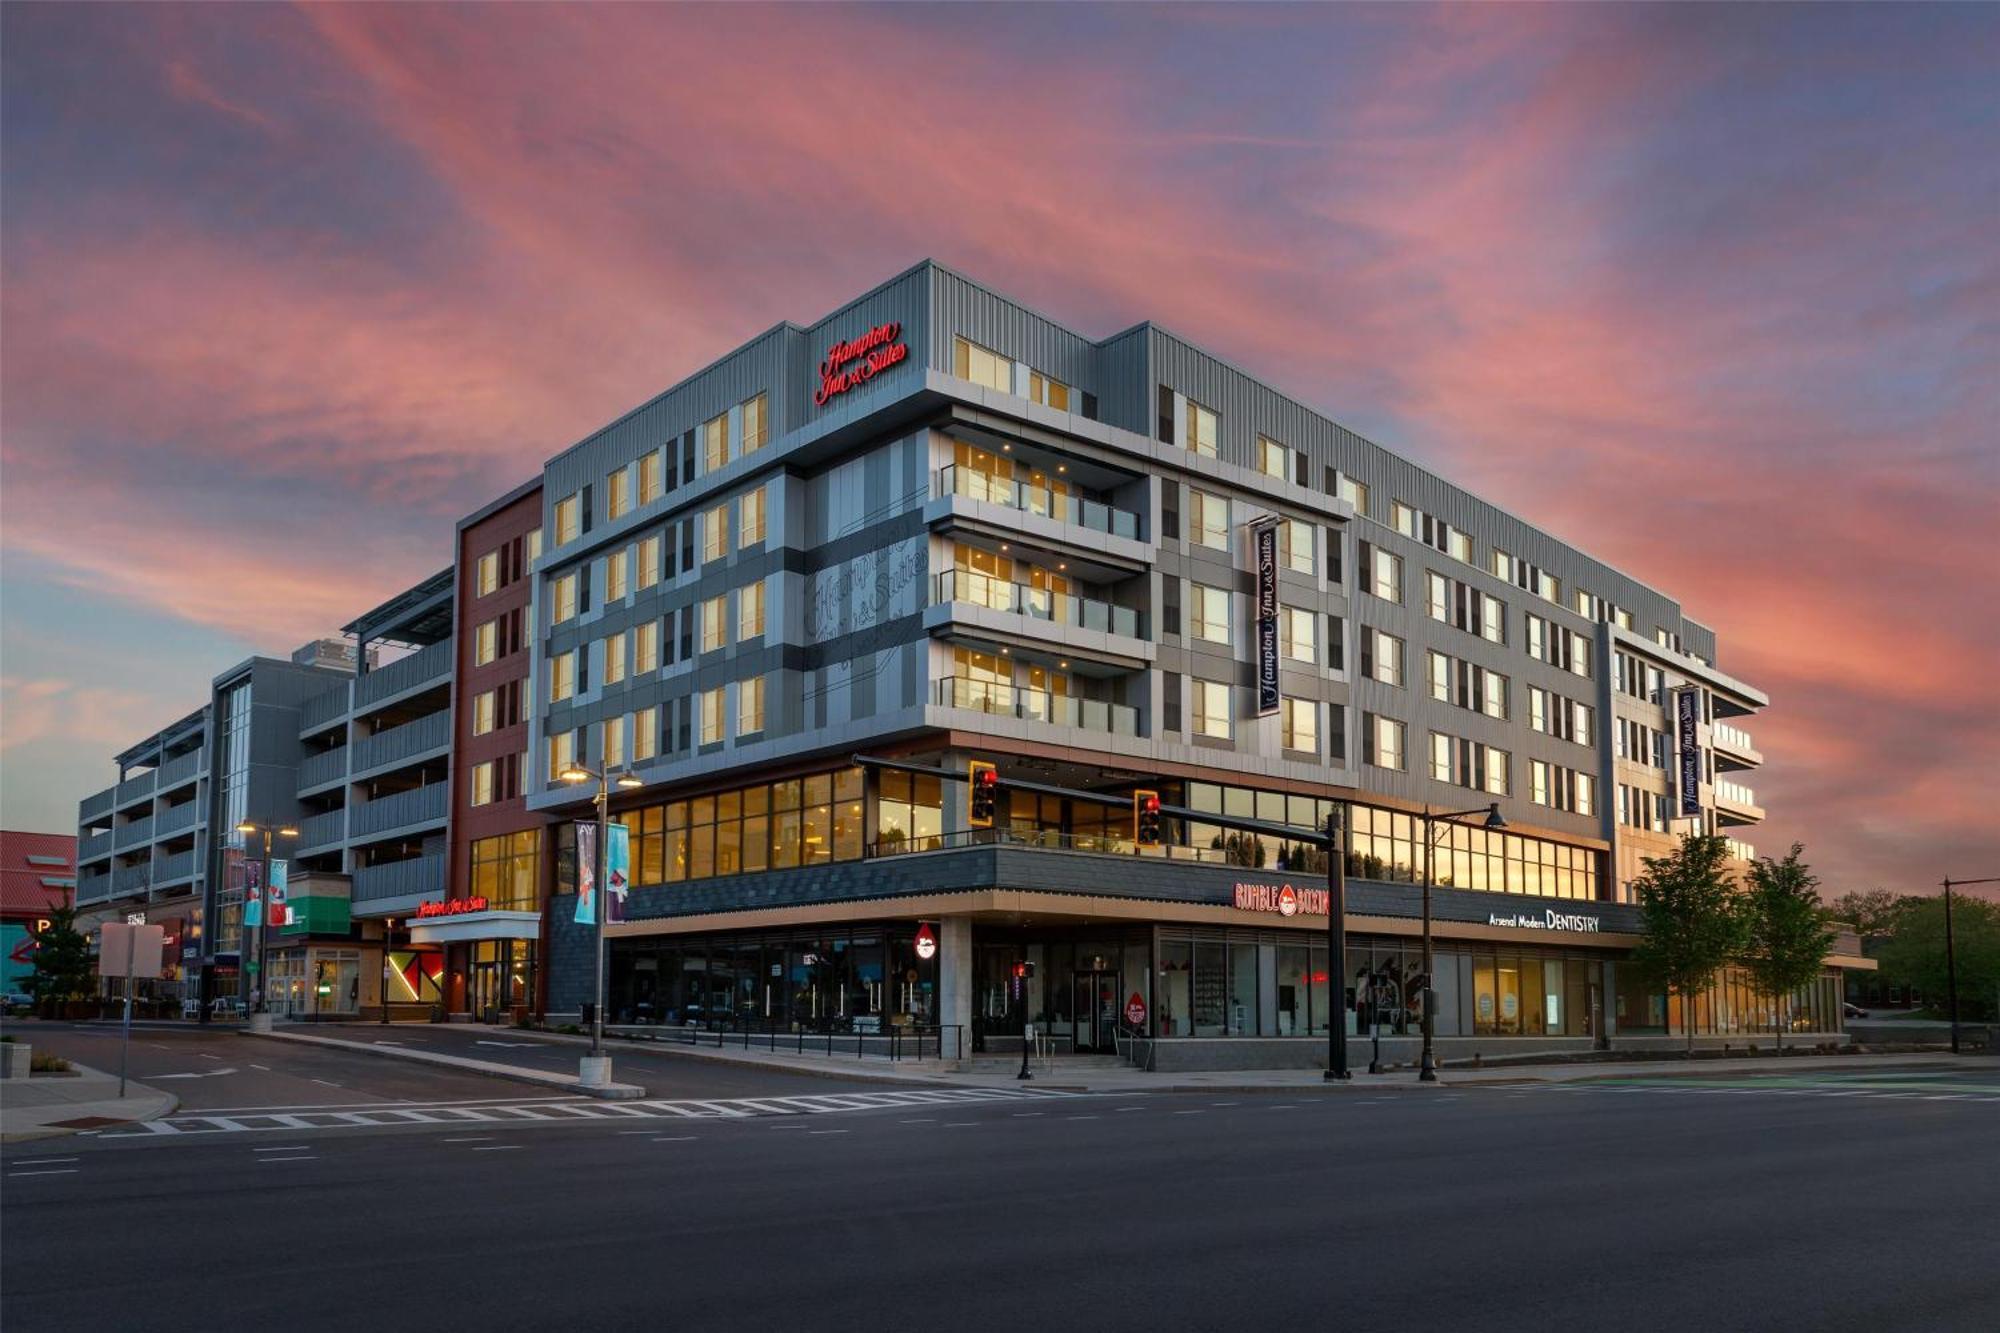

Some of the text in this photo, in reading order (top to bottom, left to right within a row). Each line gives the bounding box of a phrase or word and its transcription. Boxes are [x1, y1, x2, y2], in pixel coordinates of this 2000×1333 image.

[820, 321, 900, 378] Hampton
[815, 374, 853, 404] Inn
[861, 343, 906, 378] Suites
[1261, 533, 1277, 702] Hampton Inn & Suites
[1235, 883, 1279, 912] RUMBLE
[1297, 888, 1329, 915] BOXIN
[1489, 909, 1599, 932] Arsenal Modern DENTISTRY
[37, 918, 52, 934] P
